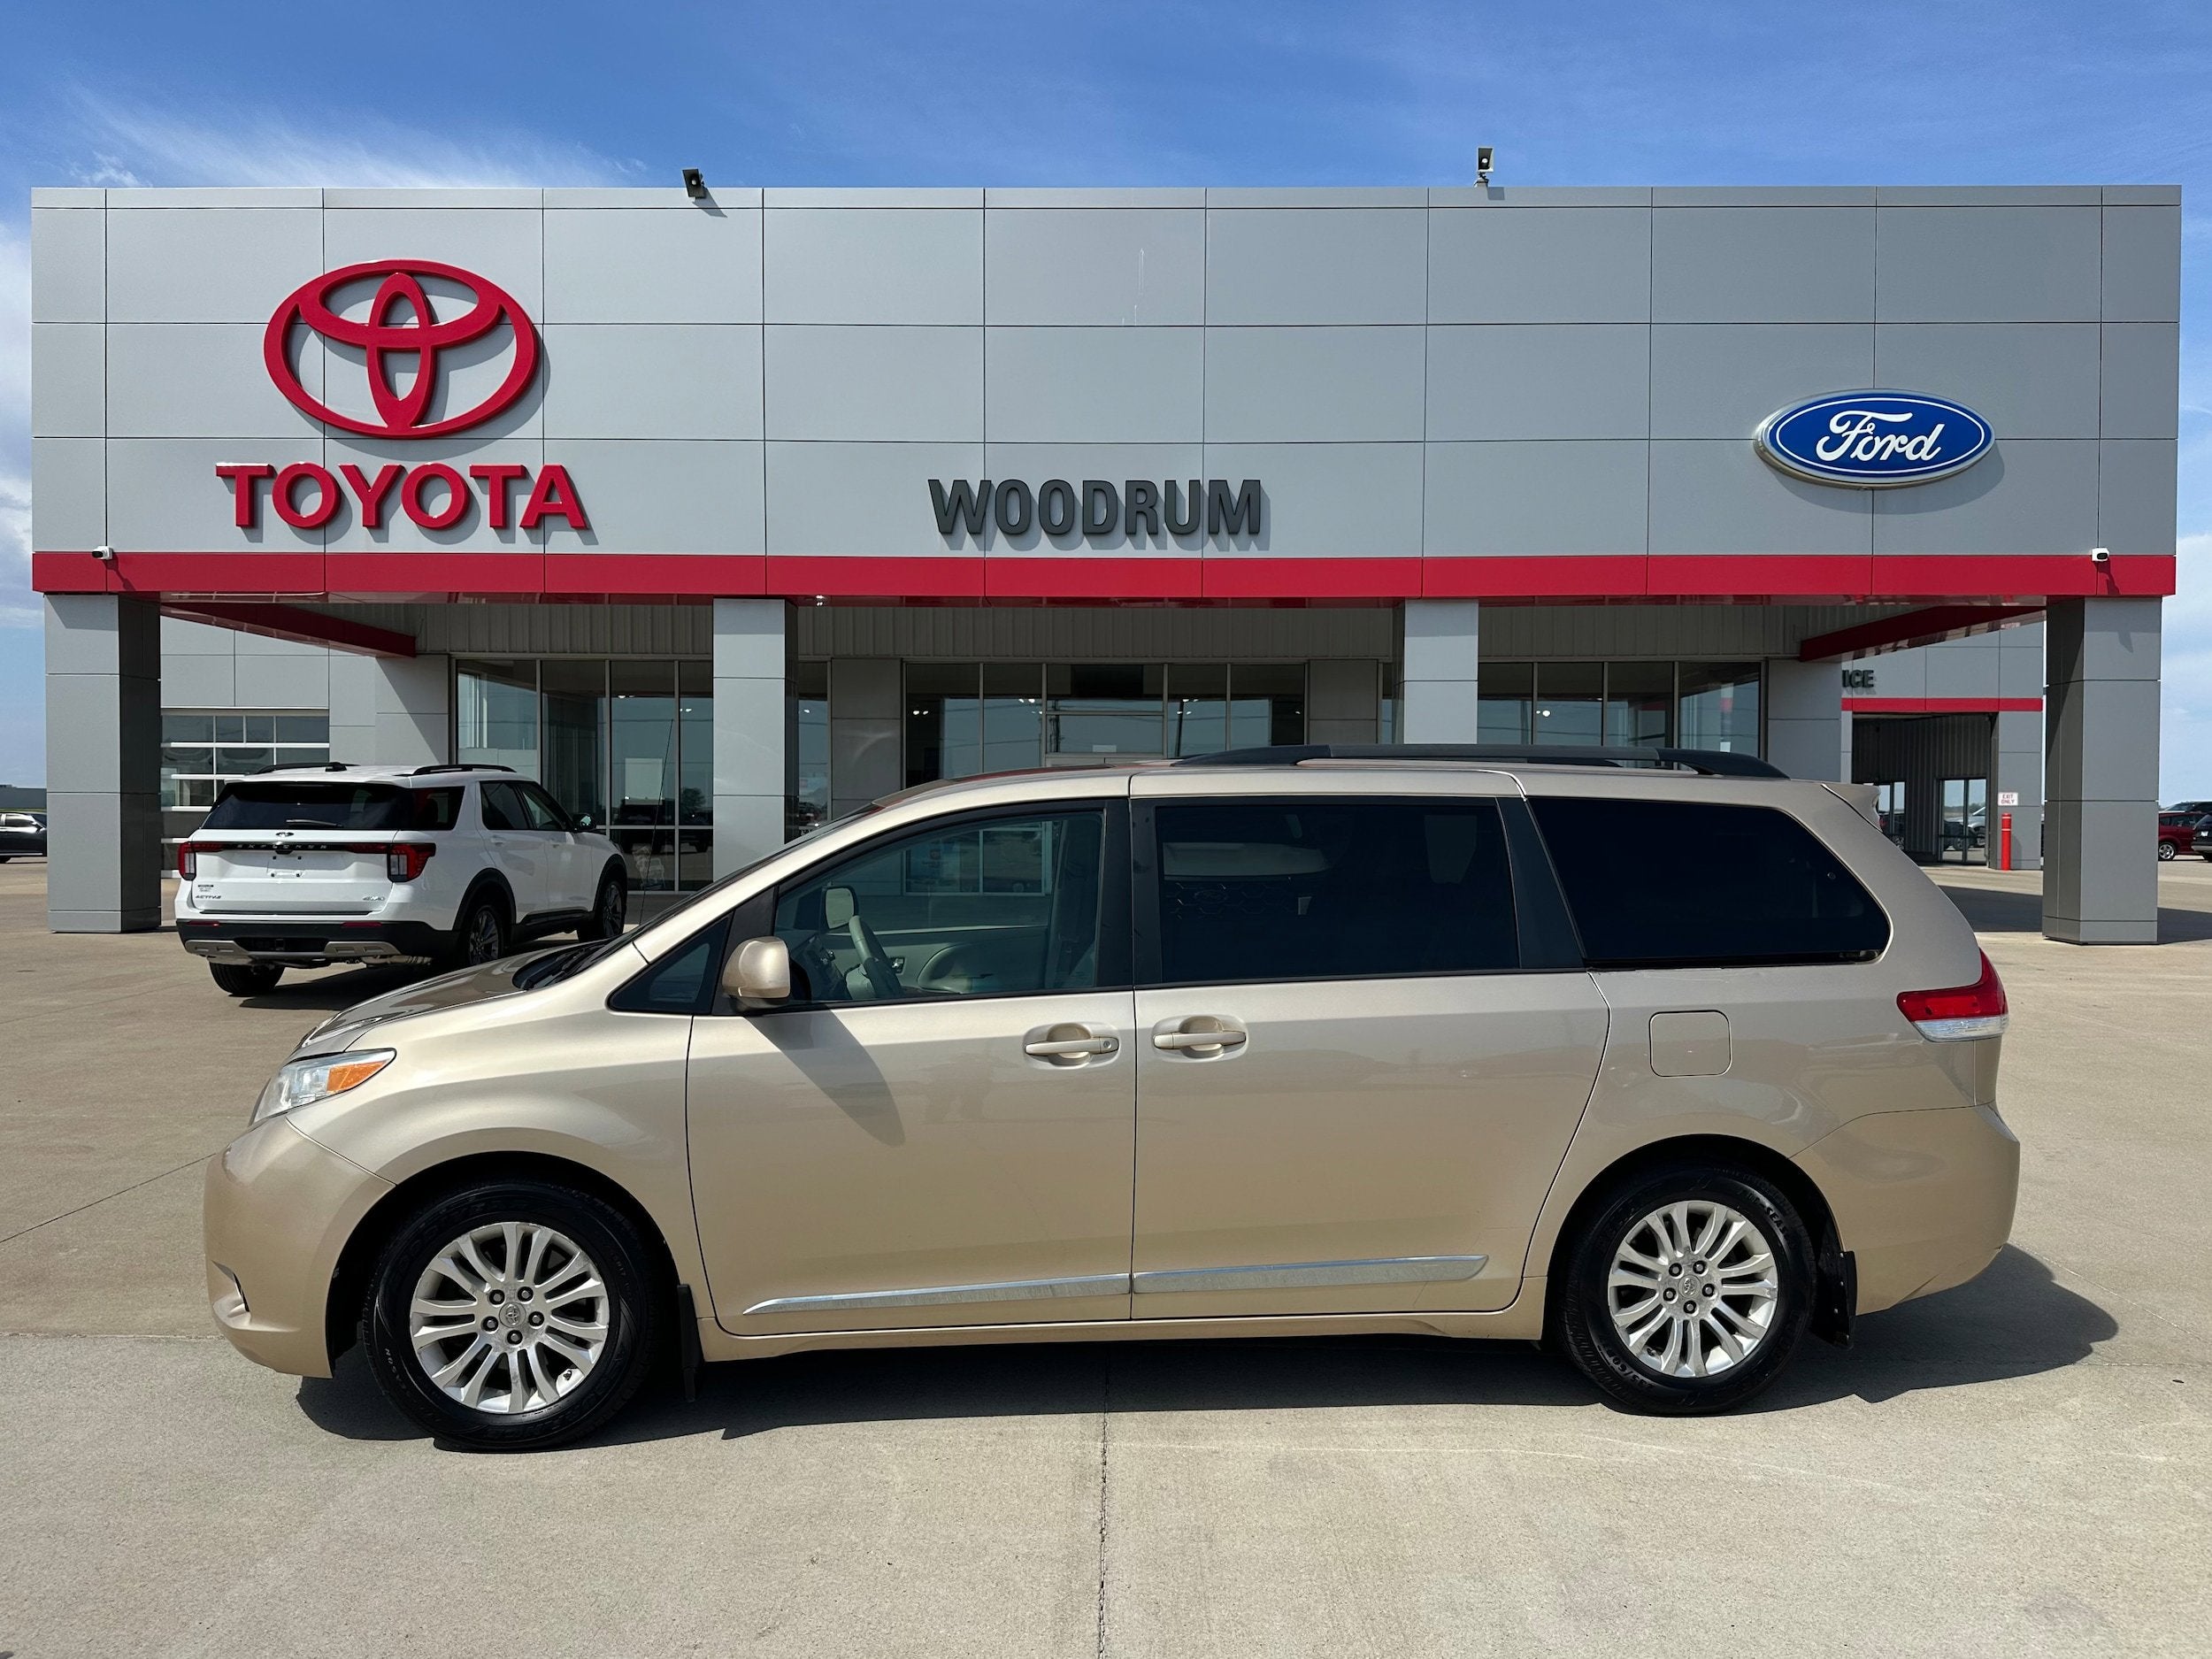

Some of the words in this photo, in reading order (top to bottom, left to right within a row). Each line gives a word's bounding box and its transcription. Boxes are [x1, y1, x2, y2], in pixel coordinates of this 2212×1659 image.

[1816, 410, 1946, 462] Ford
[216, 462, 590, 530] TOYOTA
[927, 479, 1262, 535] WOODRUM
